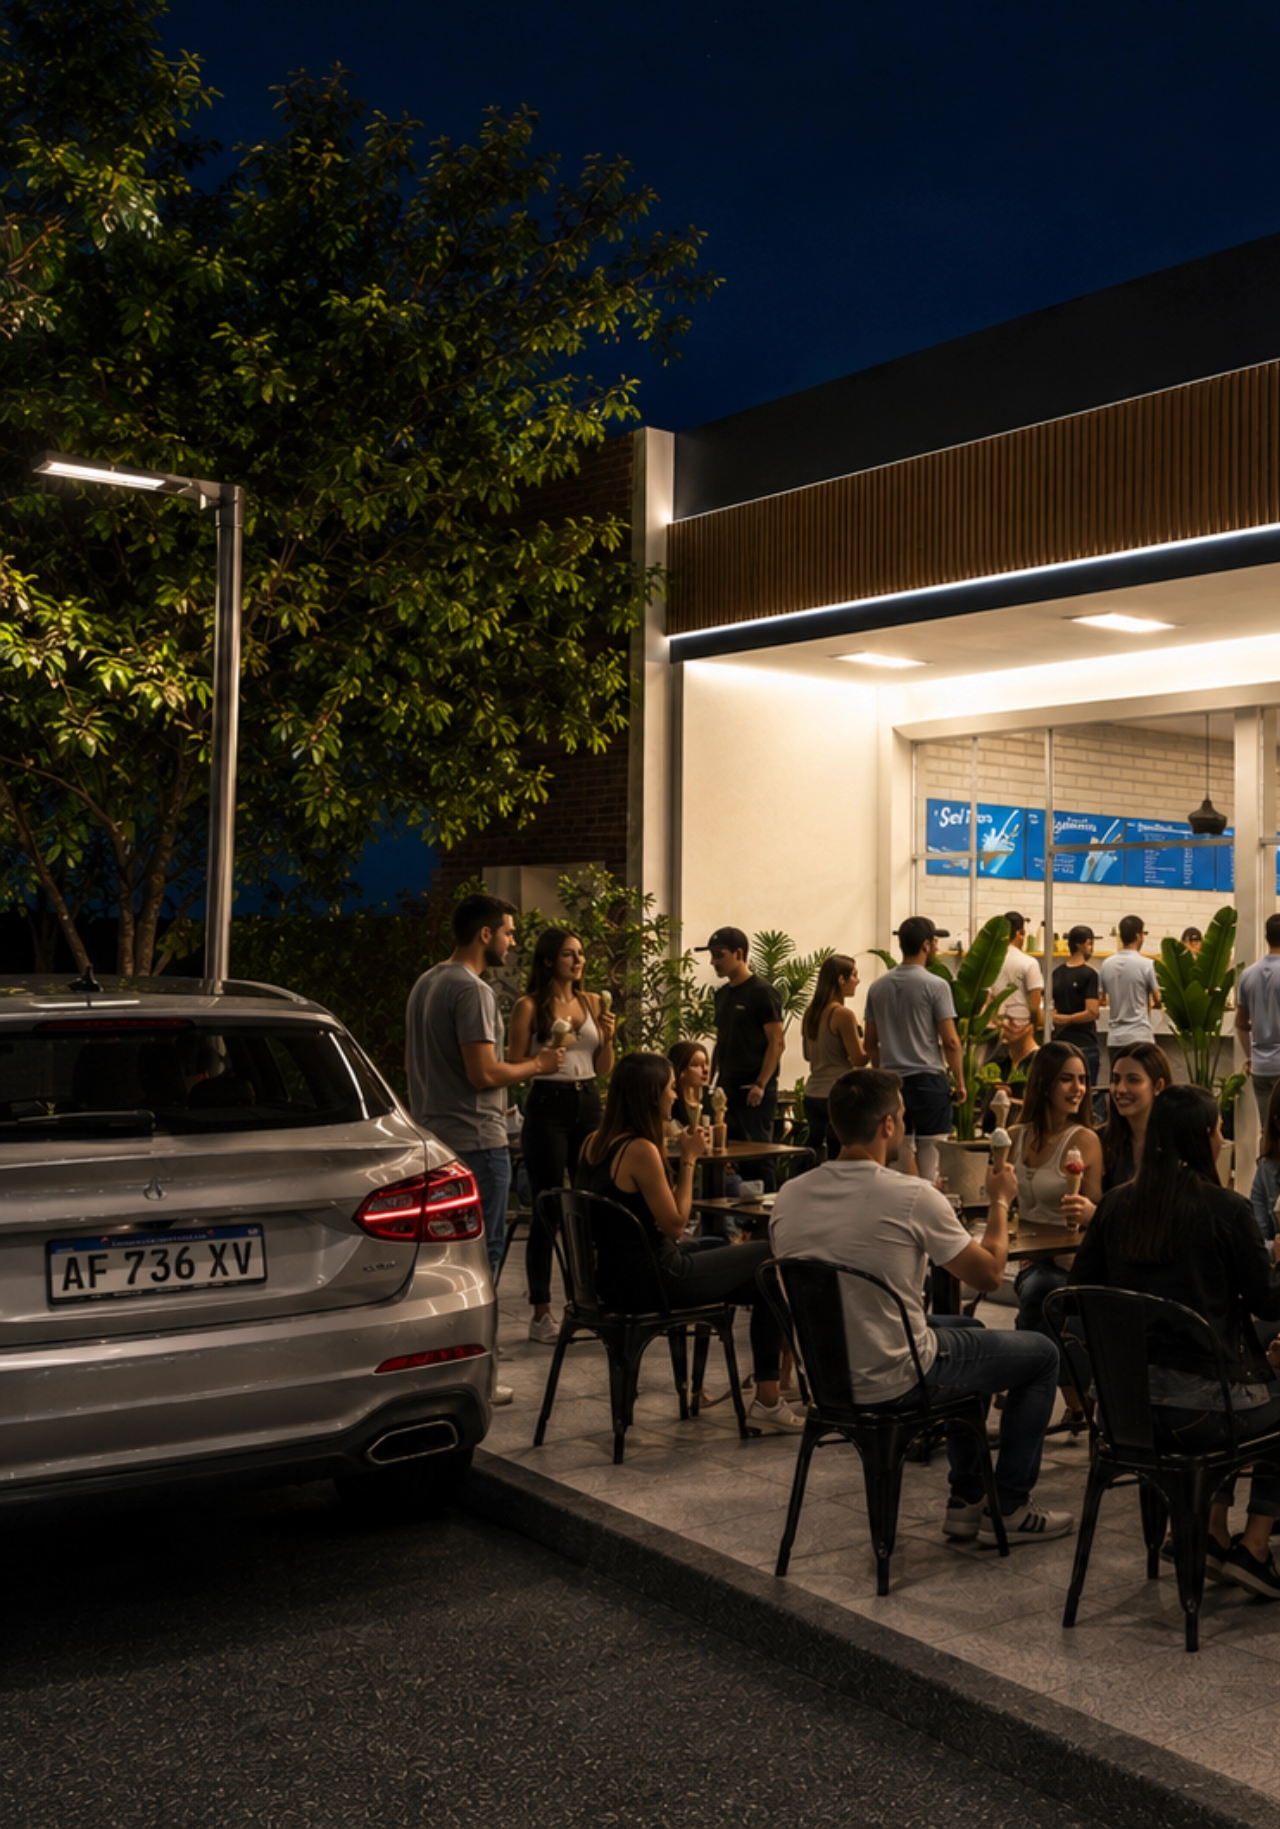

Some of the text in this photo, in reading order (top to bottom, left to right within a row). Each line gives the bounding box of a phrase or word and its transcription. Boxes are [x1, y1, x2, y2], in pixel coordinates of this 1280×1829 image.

[62, 1255, 108, 1291] AF
[124, 1246, 195, 1285] 736
[208, 1241, 252, 1278] XV
